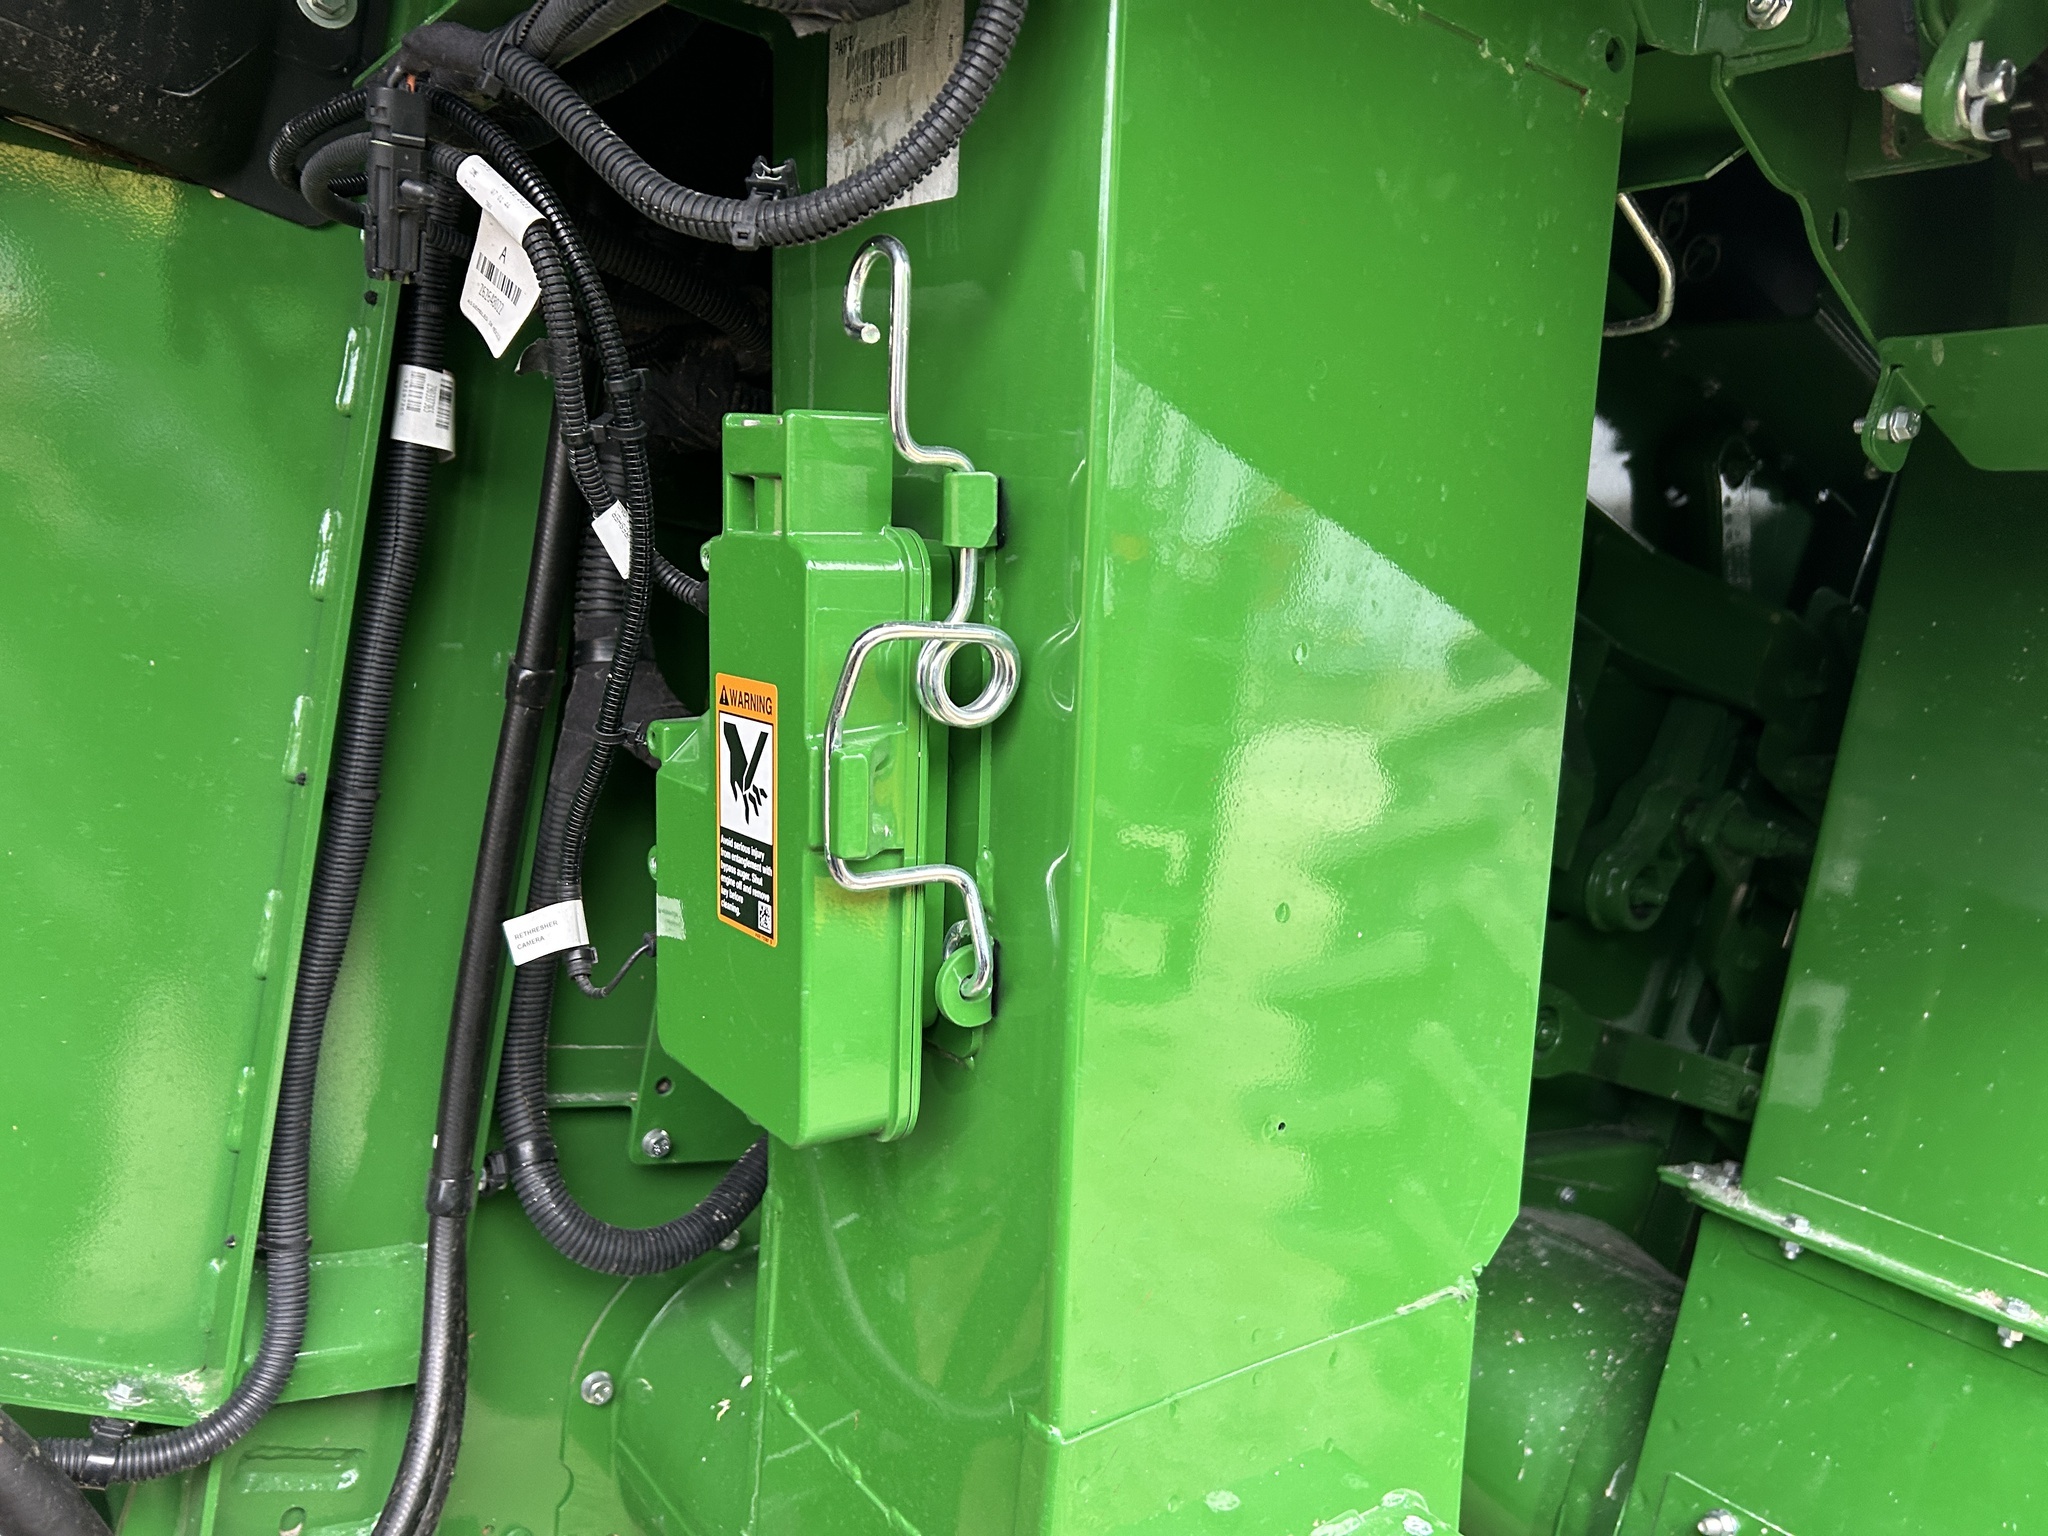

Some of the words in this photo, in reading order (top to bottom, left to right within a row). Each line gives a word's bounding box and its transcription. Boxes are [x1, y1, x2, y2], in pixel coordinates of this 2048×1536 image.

[498, 246, 508, 264] A
[729, 688, 773, 716] WARNING
[720, 834, 734, 848] Avoid
[733, 841, 751, 855] serious
[751, 845, 765, 862] injury
[720, 847, 731, 857] from
[731, 853, 762, 873] entanglement
[762, 865, 773, 877] with
[720, 859, 737, 875] bypass
[751, 872, 764, 887] Shut
[720, 874, 736, 888] engine
[735, 880, 743, 891] off
[742, 883, 752, 895] and
[752, 888, 770, 902] remove
[720, 885, 729, 899] key
[728, 888, 744, 904] before
[514, 920, 558, 940] RETHRESHER
[516, 935, 545, 950] CAMERA
